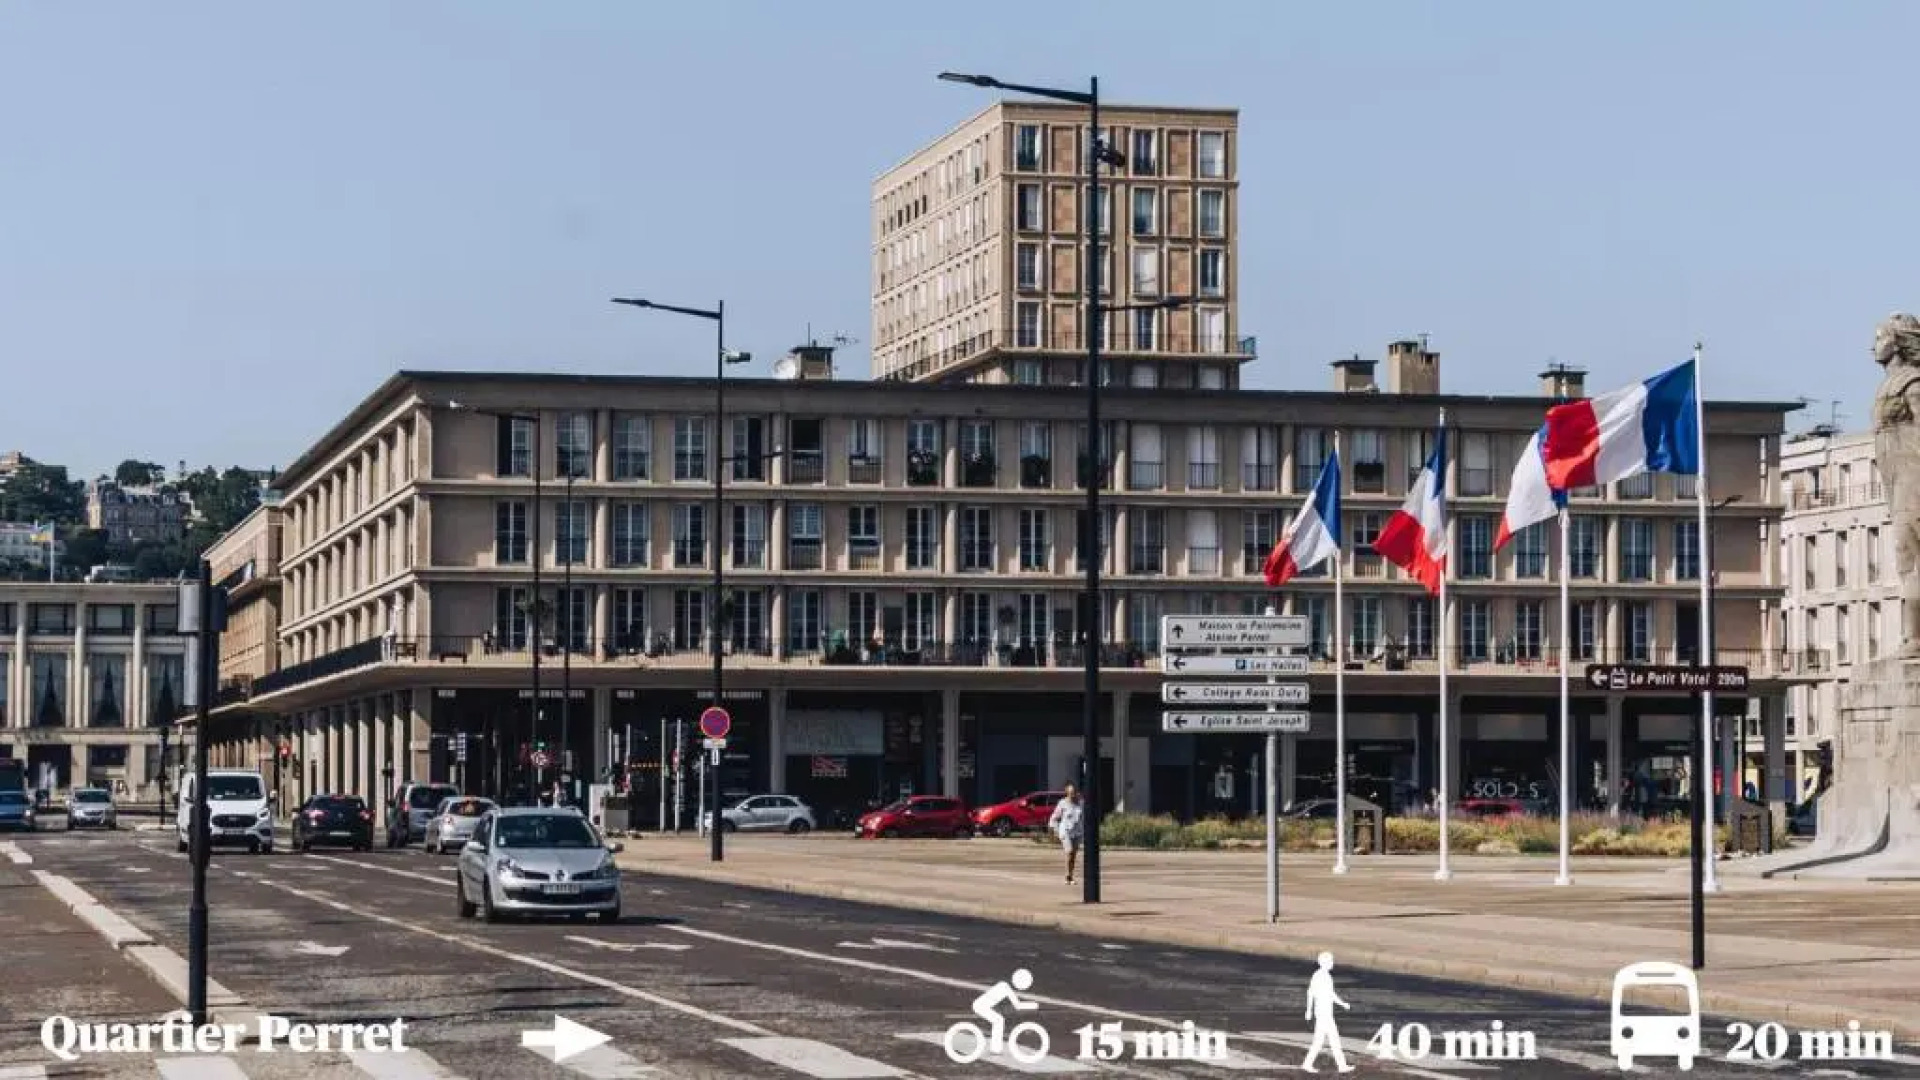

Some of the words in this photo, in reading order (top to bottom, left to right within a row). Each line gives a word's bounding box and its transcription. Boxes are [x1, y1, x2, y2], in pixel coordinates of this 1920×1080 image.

[1198, 621, 1232, 630] Maison
[1205, 633, 1238, 642] Atelier
[1241, 633, 1270, 642] Perret
[1647, 671, 1676, 685] Petit
[1237, 715, 1263, 725] Saint
[1268, 715, 1301, 727] Joseph
[1473, 781, 1538, 798] SOLDS
